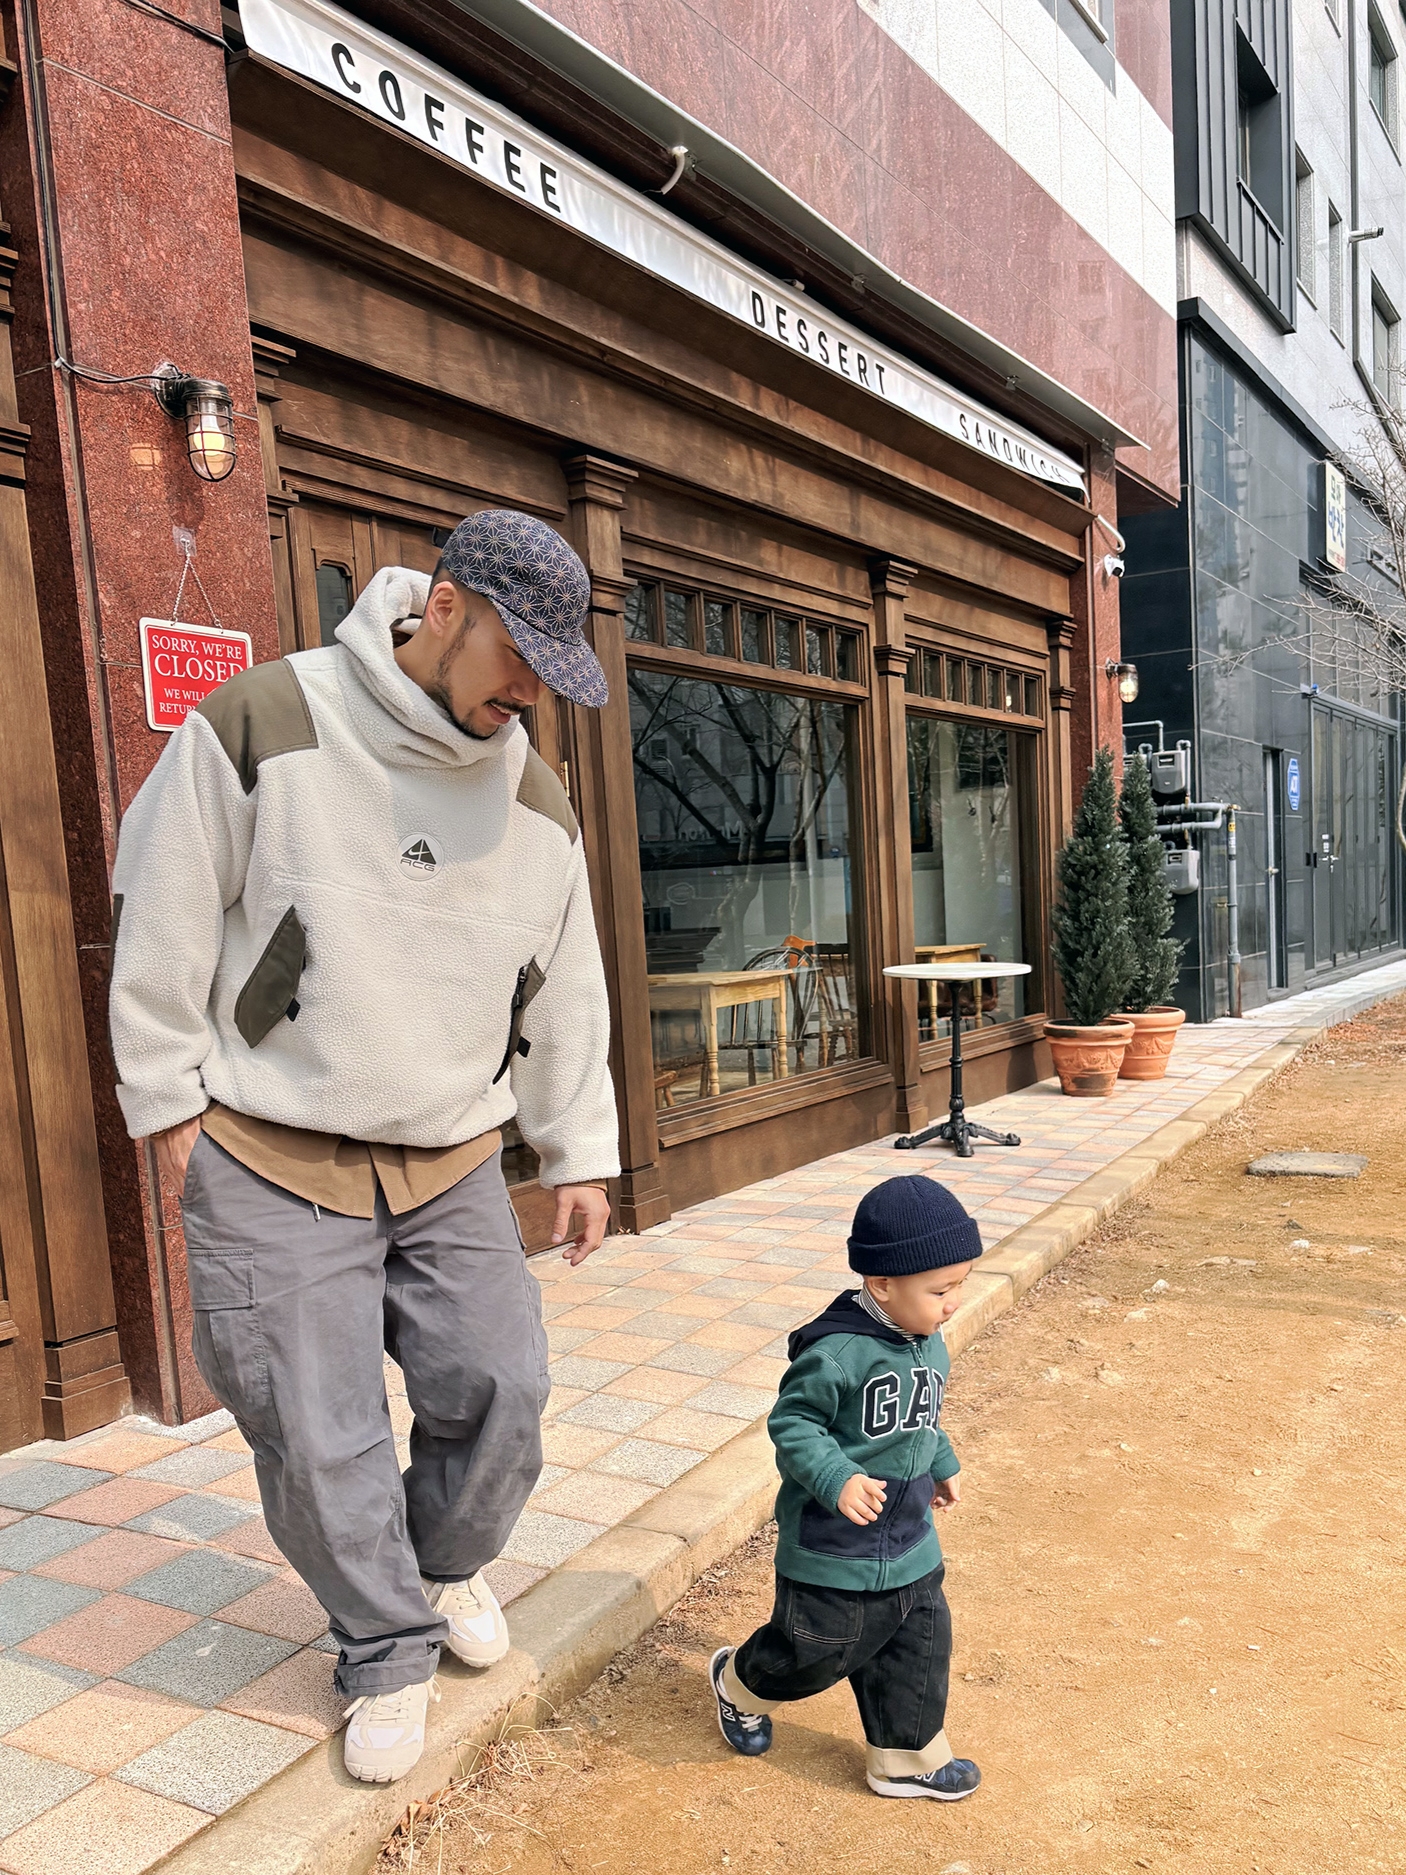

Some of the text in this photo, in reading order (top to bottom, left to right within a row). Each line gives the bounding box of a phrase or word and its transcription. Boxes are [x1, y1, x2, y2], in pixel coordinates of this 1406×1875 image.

[331, 42, 561, 213] COFFEE
[751, 290, 886, 396] DESSERT
[959, 413, 1070, 484] SANDWICH
[152, 634, 243, 660] SORRY, WE'RE
[163, 687, 181, 700] WE
[159, 701, 196, 715] RETUR
[400, 858, 436, 872] ACG
